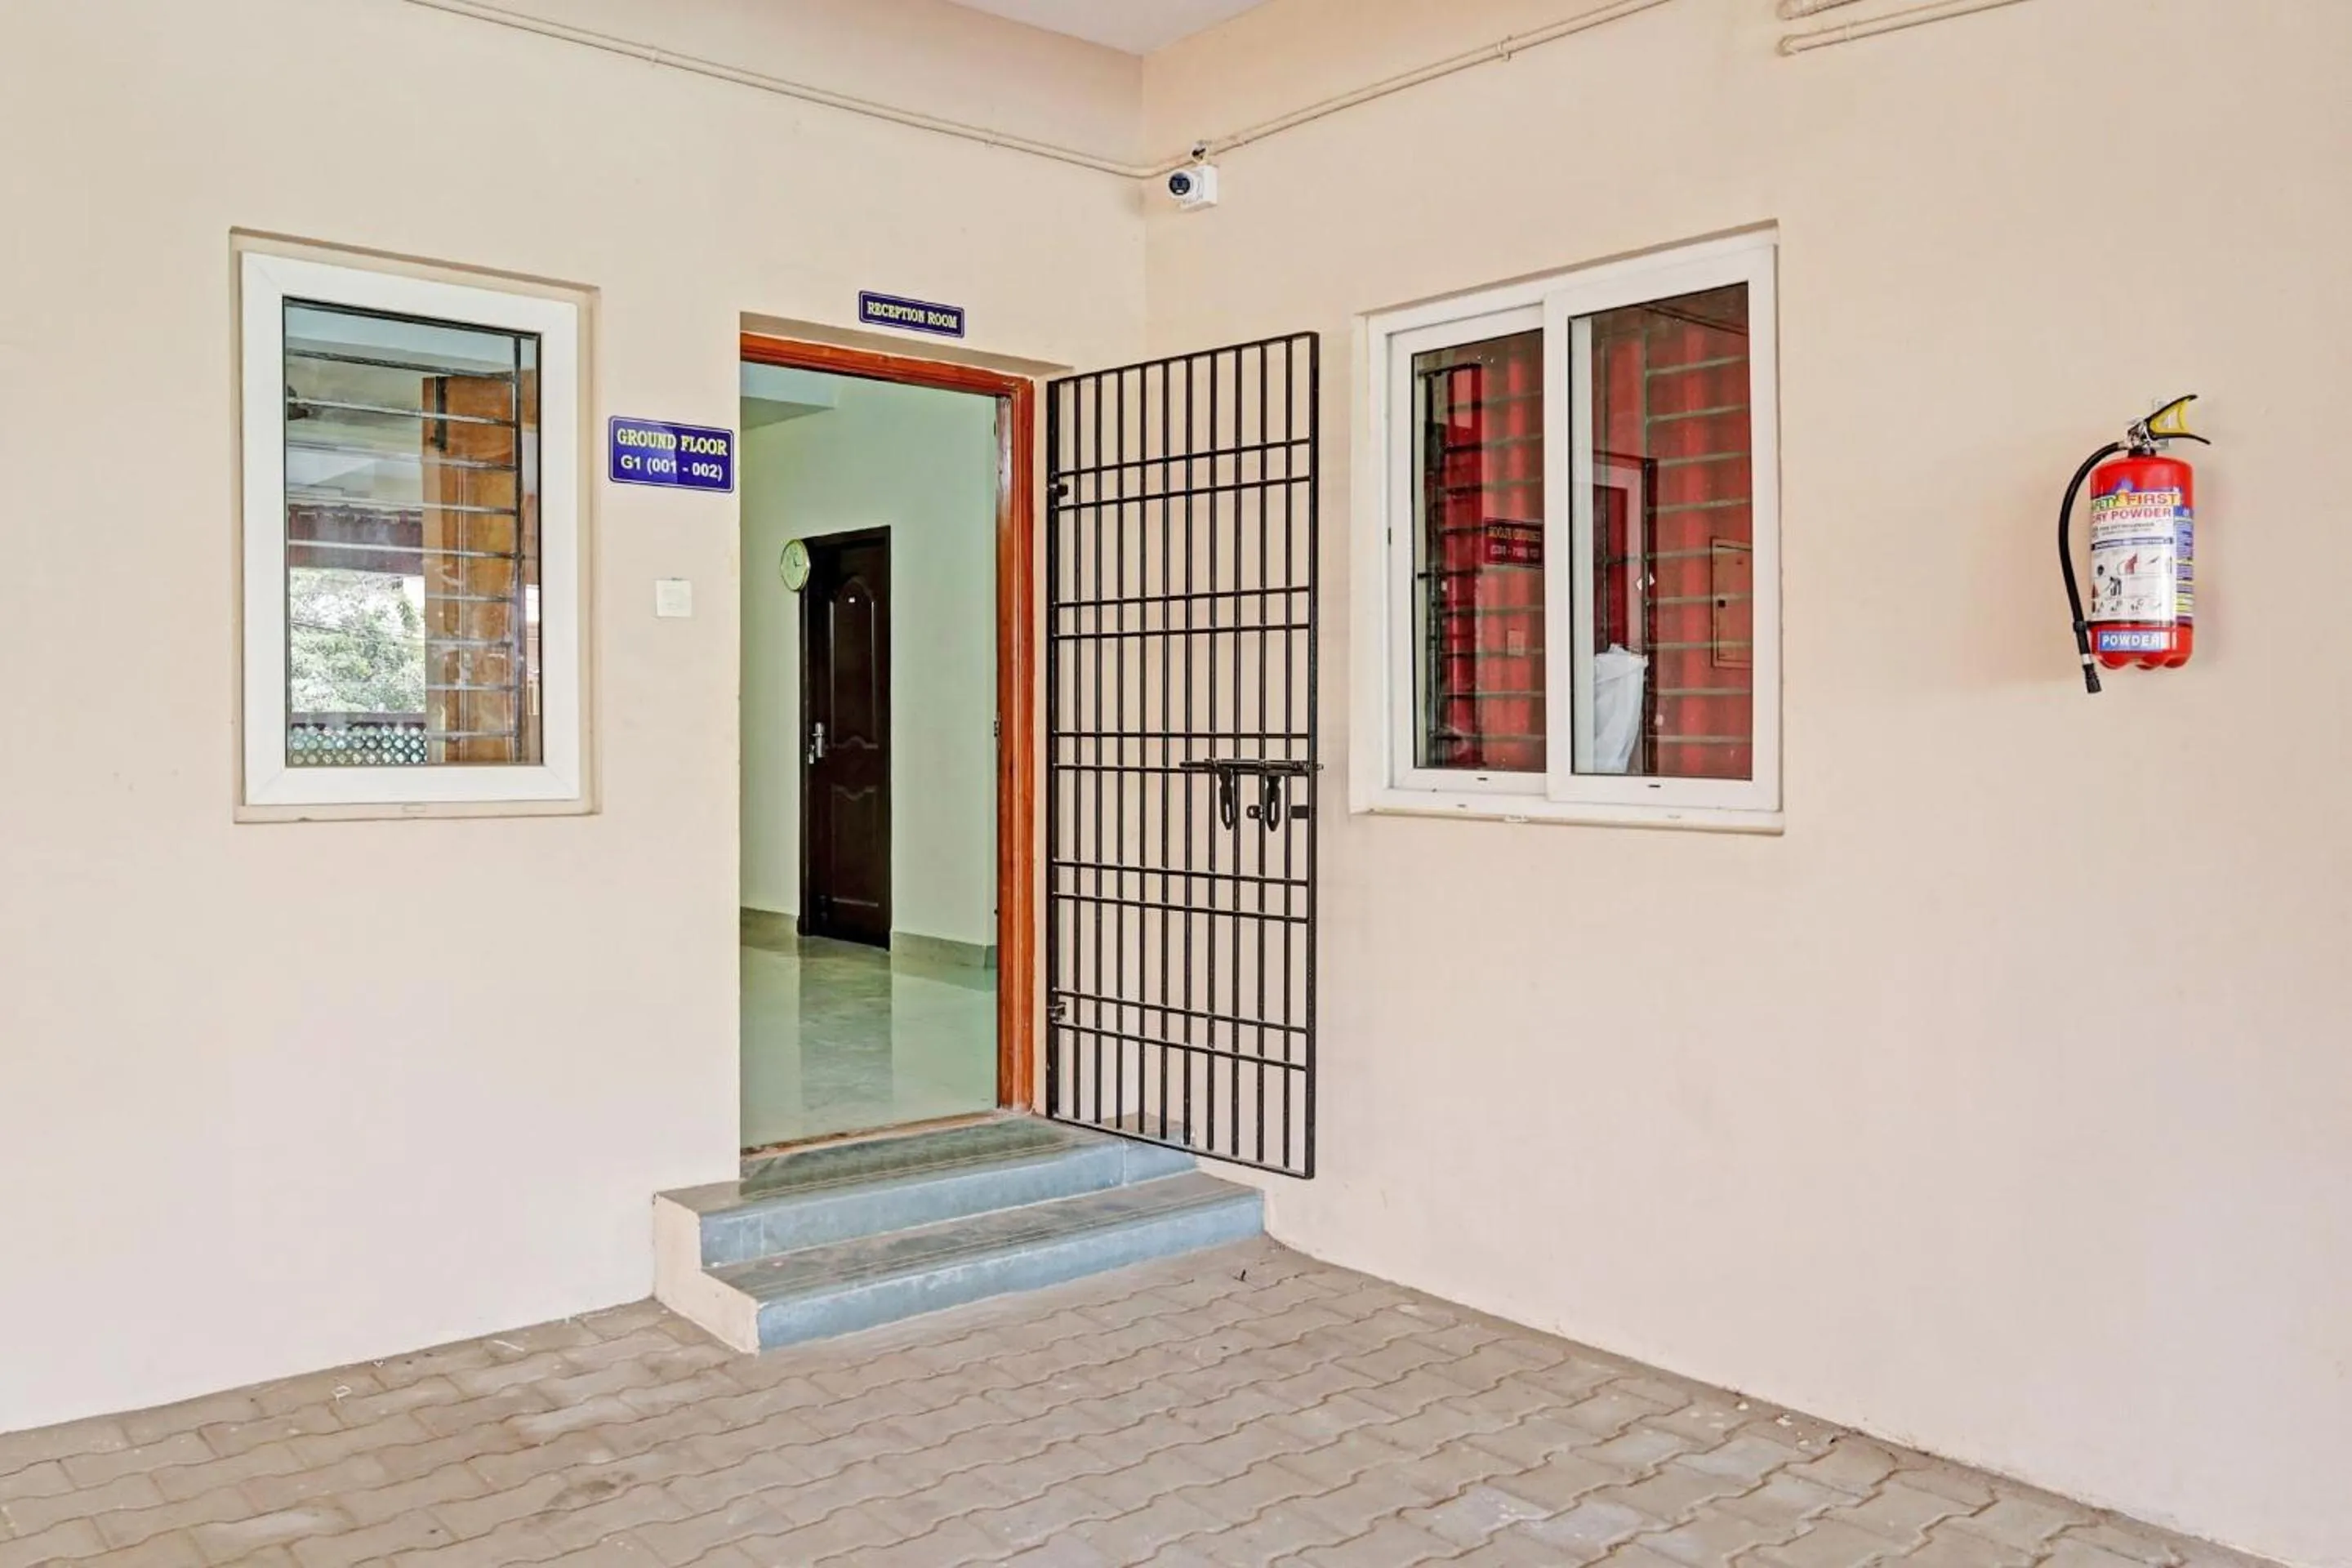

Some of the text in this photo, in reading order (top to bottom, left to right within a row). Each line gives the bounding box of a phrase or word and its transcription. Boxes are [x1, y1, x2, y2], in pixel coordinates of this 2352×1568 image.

[867, 301, 957, 328] RECEPTION ROOM
[617, 428, 728, 456] GROUND FLOOR
[620, 454, 641, 470] G1
[647, 457, 677, 475] (001
[692, 462, 723, 482] 002)
[2127, 492, 2178, 505] FIRST
[2112, 507, 2172, 520] POWDER
